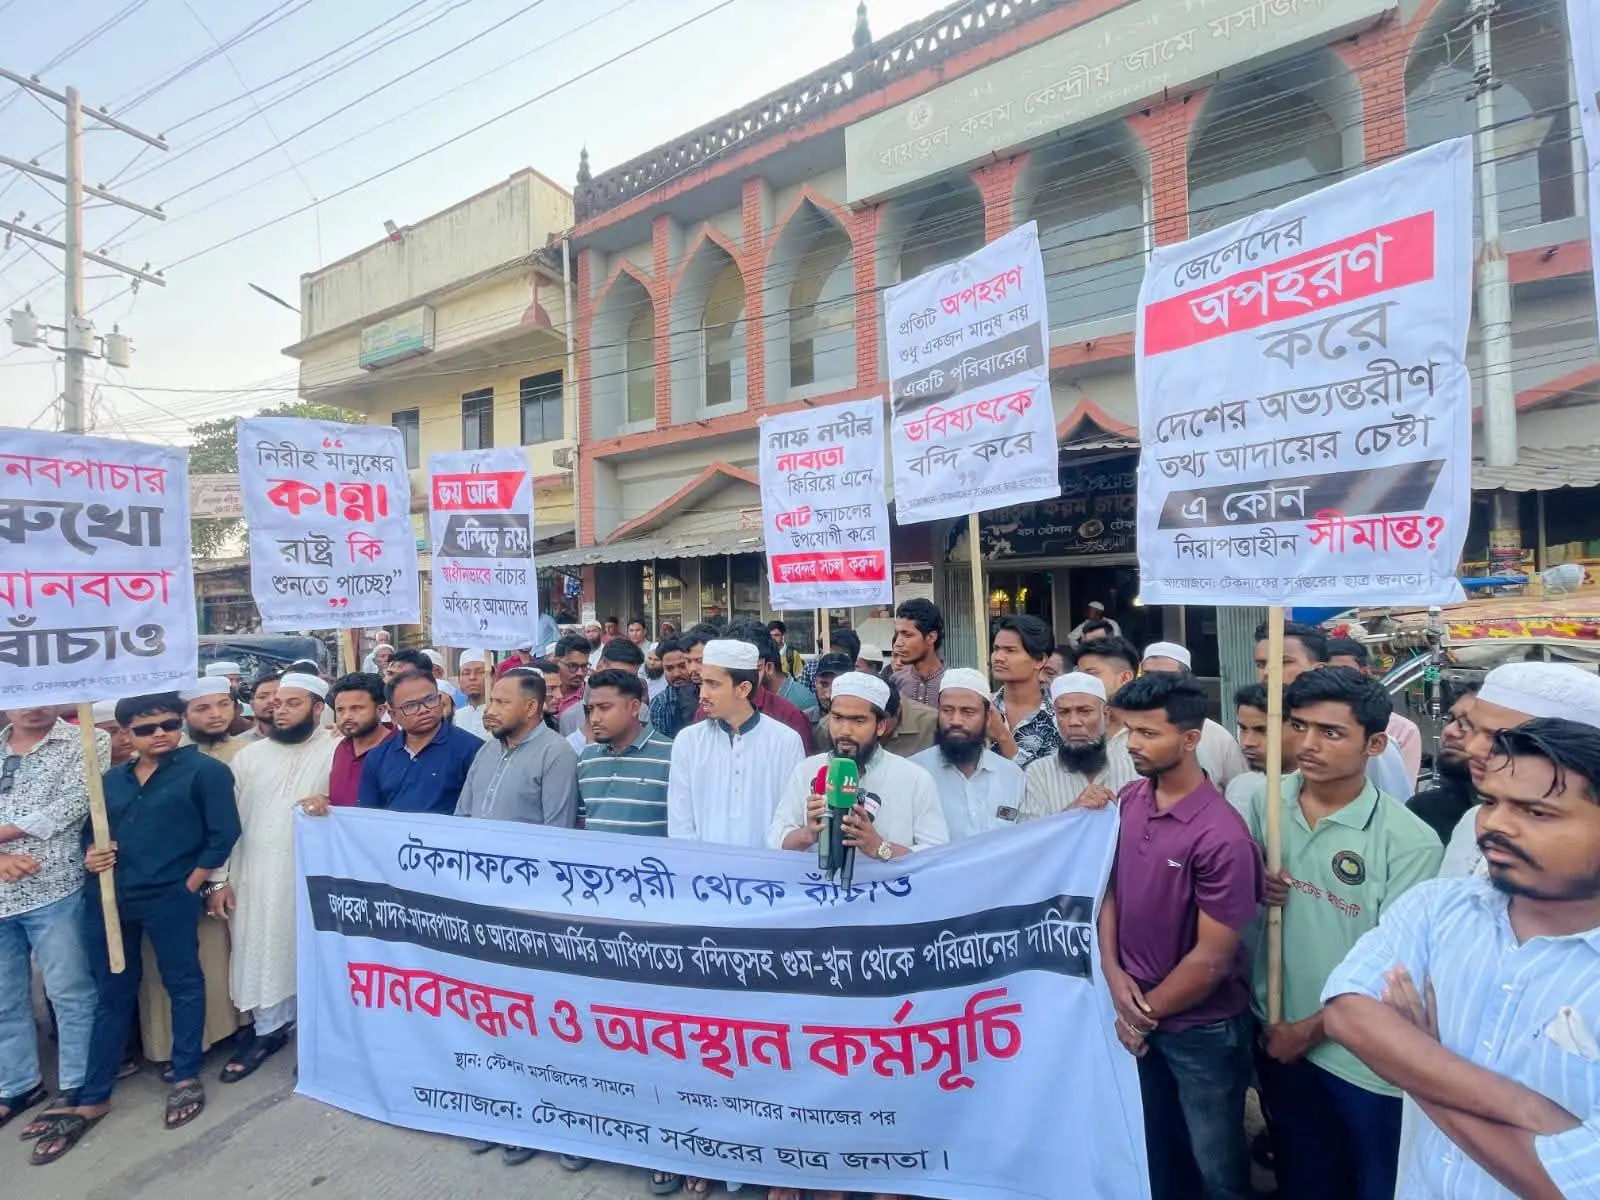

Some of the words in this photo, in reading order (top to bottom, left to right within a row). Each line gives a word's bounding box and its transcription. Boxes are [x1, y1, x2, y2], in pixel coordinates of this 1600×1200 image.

[878, 125, 951, 168] বায়তুল
[959, 100, 1014, 136] করম
[1024, 65, 1113, 114] কেন্দ্রীয়
[1122, 27, 1198, 72] জামে
[1174, 215, 1307, 288] জেলেদের
[899, 307, 938, 335] প্রতিটি
[939, 264, 1025, 316] অপহরণ
[1188, 232, 1394, 328] অপহরণ
[899, 345, 919, 364] শুধু
[922, 328, 964, 354] একজন
[968, 313, 1003, 337] মানুষ
[1008, 303, 1030, 322] নয়
[1255, 300, 1400, 370] করে
[903, 369, 945, 397] একটি
[950, 345, 1030, 384] পরিবারের
[903, 388, 1036, 442] ভবিষ্যৎকে
[1156, 399, 1249, 443] দেশের
[1256, 358, 1440, 422] অভ্যন্তরীণ
[768, 427, 809, 450] নাফ
[818, 410, 873, 443] নদীর
[906, 445, 964, 478] বন্দি
[970, 431, 1036, 463] করে
[1156, 449, 1210, 480] তথ্য
[1215, 431, 1342, 472] আদায়ের
[1354, 411, 1436, 456] চেষ্টা
[0, 454, 168, 494] নবপাচার
[256, 440, 318, 471] নিরীহ
[323, 451, 395, 477] মানুষের
[776, 446, 845, 474] নাব্যতা
[786, 471, 835, 497] ফিরিয়ে
[840, 468, 874, 487] এনে
[265, 478, 389, 523] কান্না
[438, 481, 462, 505] ভয়
[466, 480, 499, 505] আর
[1182, 496, 1207, 523] এ
[1222, 485, 1311, 522] কোন
[455, 518, 500, 557] বন্দিত্ব
[503, 527, 529, 552] নয়
[775, 506, 812, 532] বোট
[814, 503, 872, 524] চলাচলের
[791, 524, 844, 549] উপযোগী
[847, 525, 877, 543] করে
[1173, 527, 1299, 560] নিরাপত্তাহীন
[1305, 508, 1446, 554] সীমান্ত?
[275, 531, 336, 567] রাষ্ট্র
[346, 531, 385, 564] কি
[441, 561, 491, 585] স্বাধীনভাবে
[494, 562, 526, 585] বাঁচার
[272, 575, 330, 597] শুনতে
[442, 591, 481, 615] অধিকার
[482, 599, 528, 617] আমাদের
[398, 833, 540, 886] টেকনাফকে
[548, 857, 676, 908] মৃত্যুপুরী
[692, 873, 787, 908] থেকে
[328, 893, 373, 930] অপহরণ,
[374, 899, 471, 945] মাদক-মানবপাচার
[473, 923, 487, 947] ও
[486, 922, 549, 958] আরাকান
[548, 925, 599, 965] আর্মির
[598, 931, 685, 974] আধিপত্যে
[687, 936, 778, 987] বন্দিত্বসহ
[781, 945, 854, 990] গুম-খুন
[861, 944, 916, 981] থেকে
[923, 930, 1021, 973] পরিত্রানের
[1024, 908, 1093, 957] দাবিতে
[346, 961, 540, 1038] মানববন্ধন
[548, 999, 584, 1044] ও
[589, 1002, 791, 1080] অবস্থান
[801, 985, 1022, 1091] কর্মসূচি
[454, 1050, 482, 1071] স্থান:
[486, 1052, 525, 1076] স্টেশন
[527, 1064, 588, 1088] মসজিদের
[592, 1076, 636, 1099] সামনে
[676, 1090, 717, 1110] সময়:
[721, 1095, 784, 1121] আসরের
[789, 1106, 863, 1127] নামাজের
[869, 1109, 896, 1126] পর
[413, 1085, 523, 1120] আয়োজনে:
[532, 1101, 651, 1145] টেকনাফের
[659, 1127, 764, 1165] সর্বস্তরের
[773, 1148, 830, 1170] ছাত্র
[840, 1148, 929, 1170] জনতা
